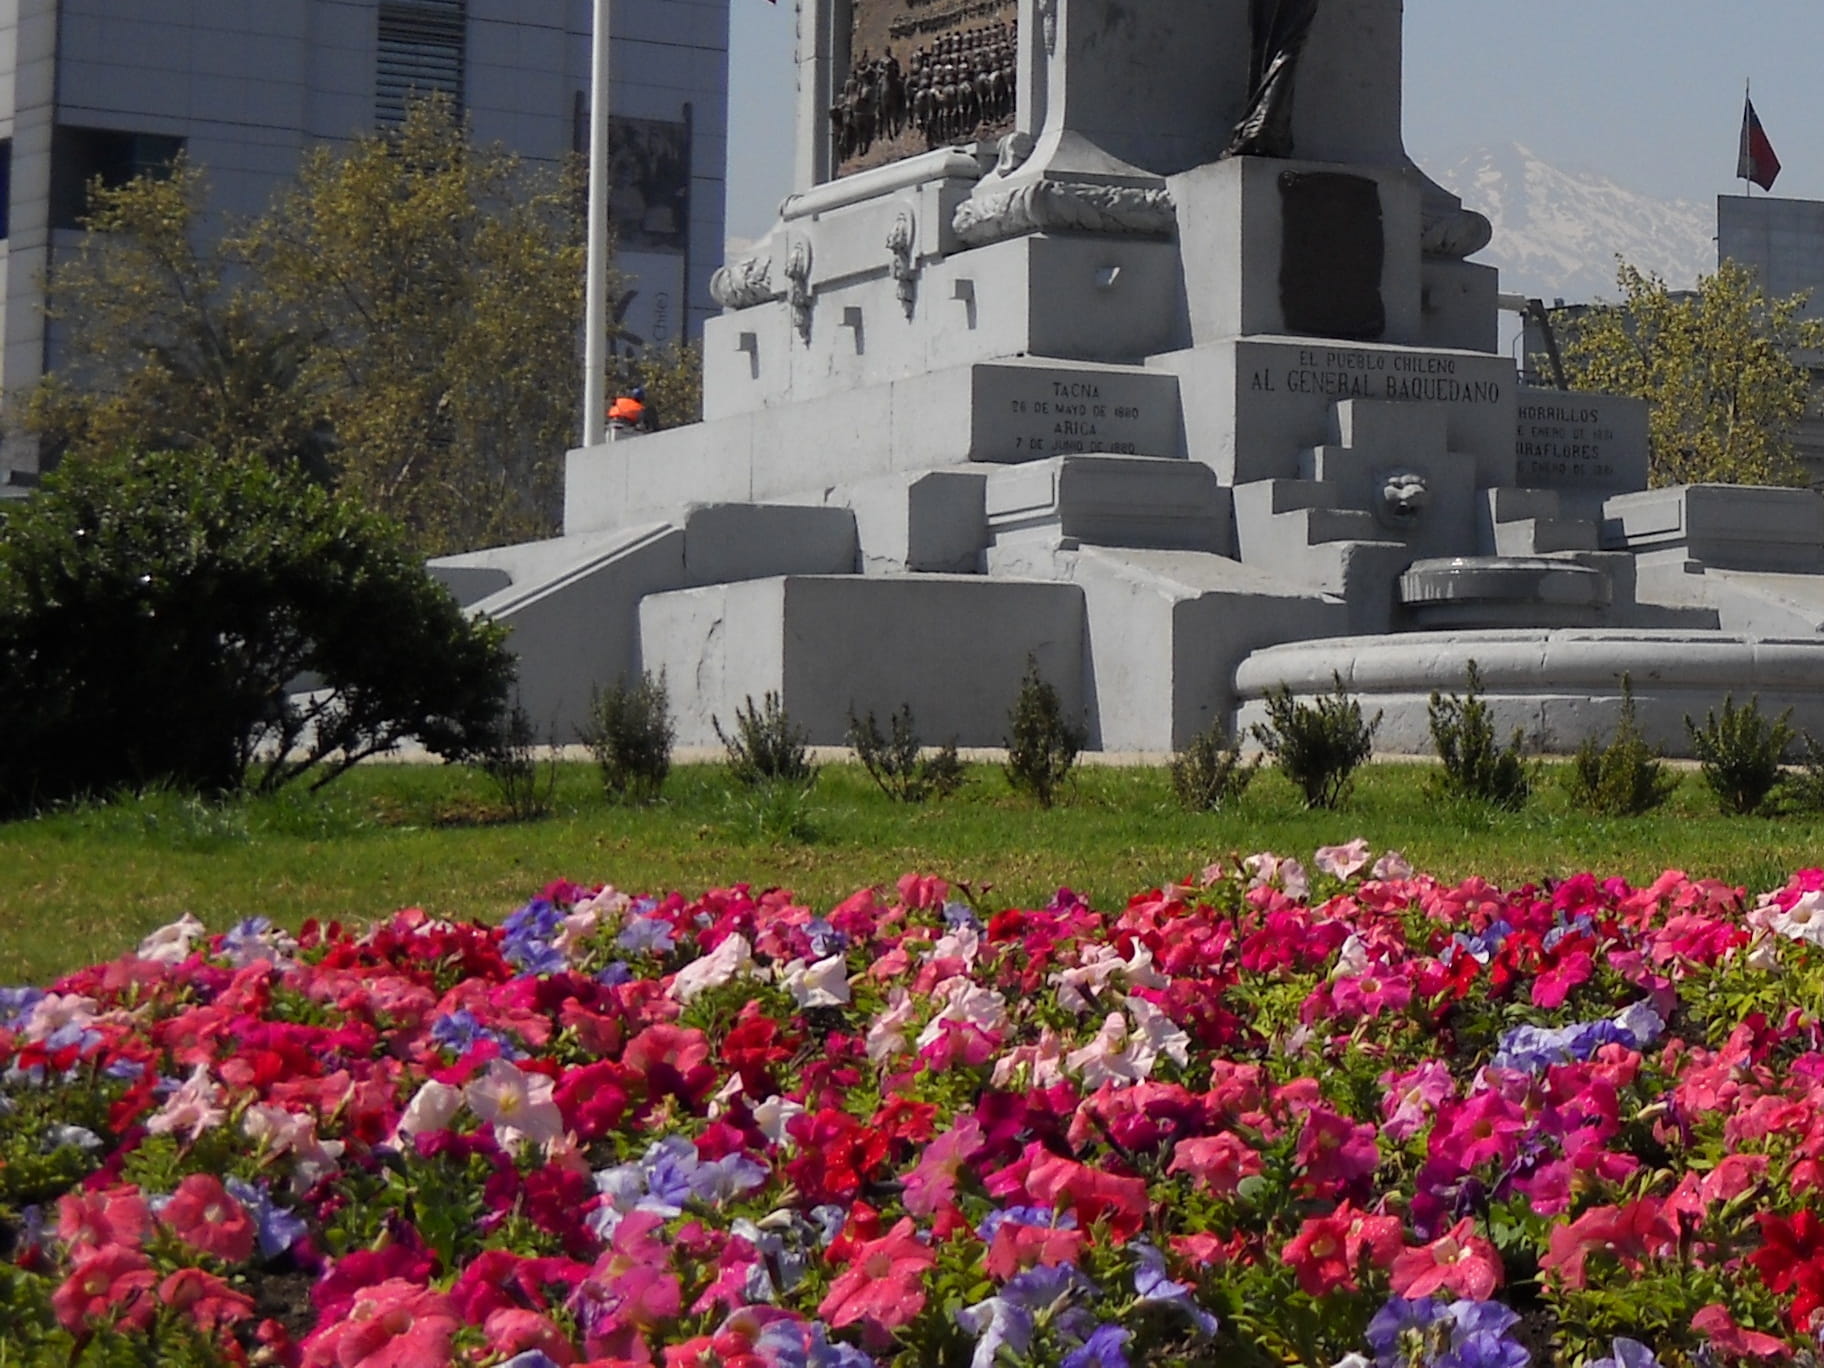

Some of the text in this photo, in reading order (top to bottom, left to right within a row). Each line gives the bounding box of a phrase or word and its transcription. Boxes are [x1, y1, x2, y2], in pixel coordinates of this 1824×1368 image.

[1299, 350, 1455, 374] EL PUEBLO CHILENO
[1053, 382, 1099, 398] TACNA
[1251, 369, 1499, 404] AL GENERAL BAQUEDANO
[1034, 401, 1049, 414] DE
[1055, 403, 1087, 416] MAYO
[1092, 405, 1107, 417] DE
[1517, 406, 1599, 423] HORRILLOS
[1054, 420, 1097, 436] ARICA
[1016, 437, 1023, 449] 7
[1030, 438, 1045, 450] DE
[1051, 440, 1084, 452] JUNIO
[1090, 441, 1104, 452] DE
